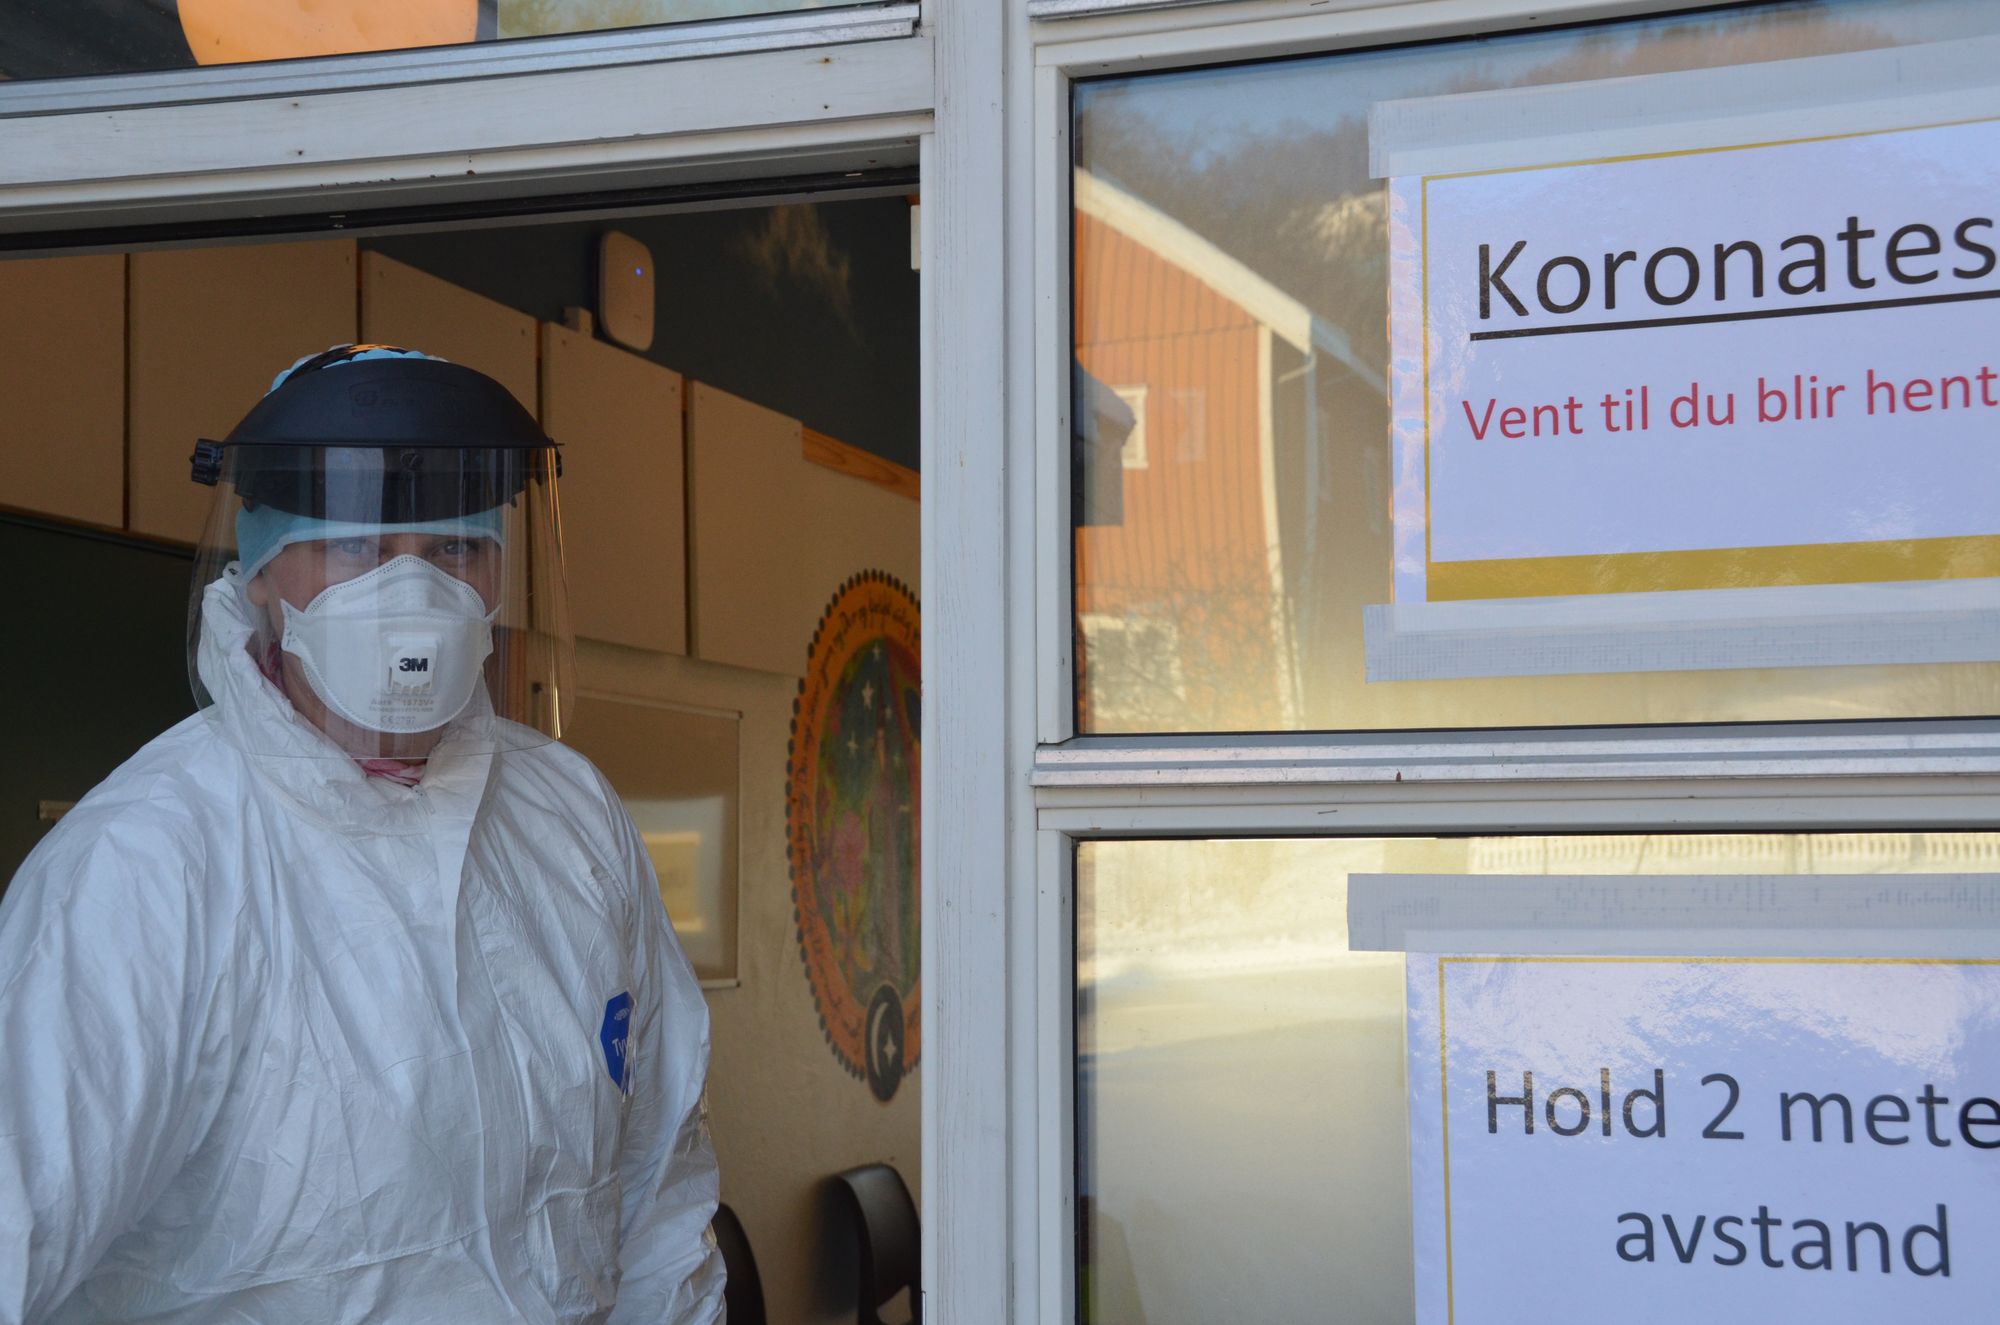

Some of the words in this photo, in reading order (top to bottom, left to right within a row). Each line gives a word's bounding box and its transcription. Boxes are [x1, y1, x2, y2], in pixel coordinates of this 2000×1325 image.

[1479, 217, 1997, 320] Koronates
[1463, 394, 1584, 441] Vent
[1600, 384, 1649, 433] til
[1670, 383, 1735, 429] du
[1758, 377, 1846, 423] blir
[1867, 367, 1998, 415] hent
[399, 657, 428, 672] 3M
[1487, 1068, 1666, 1139] Hold
[1701, 1073, 1745, 1140] 2
[1780, 1084, 2000, 1150] mete
[1616, 1204, 1951, 1278] avstand
